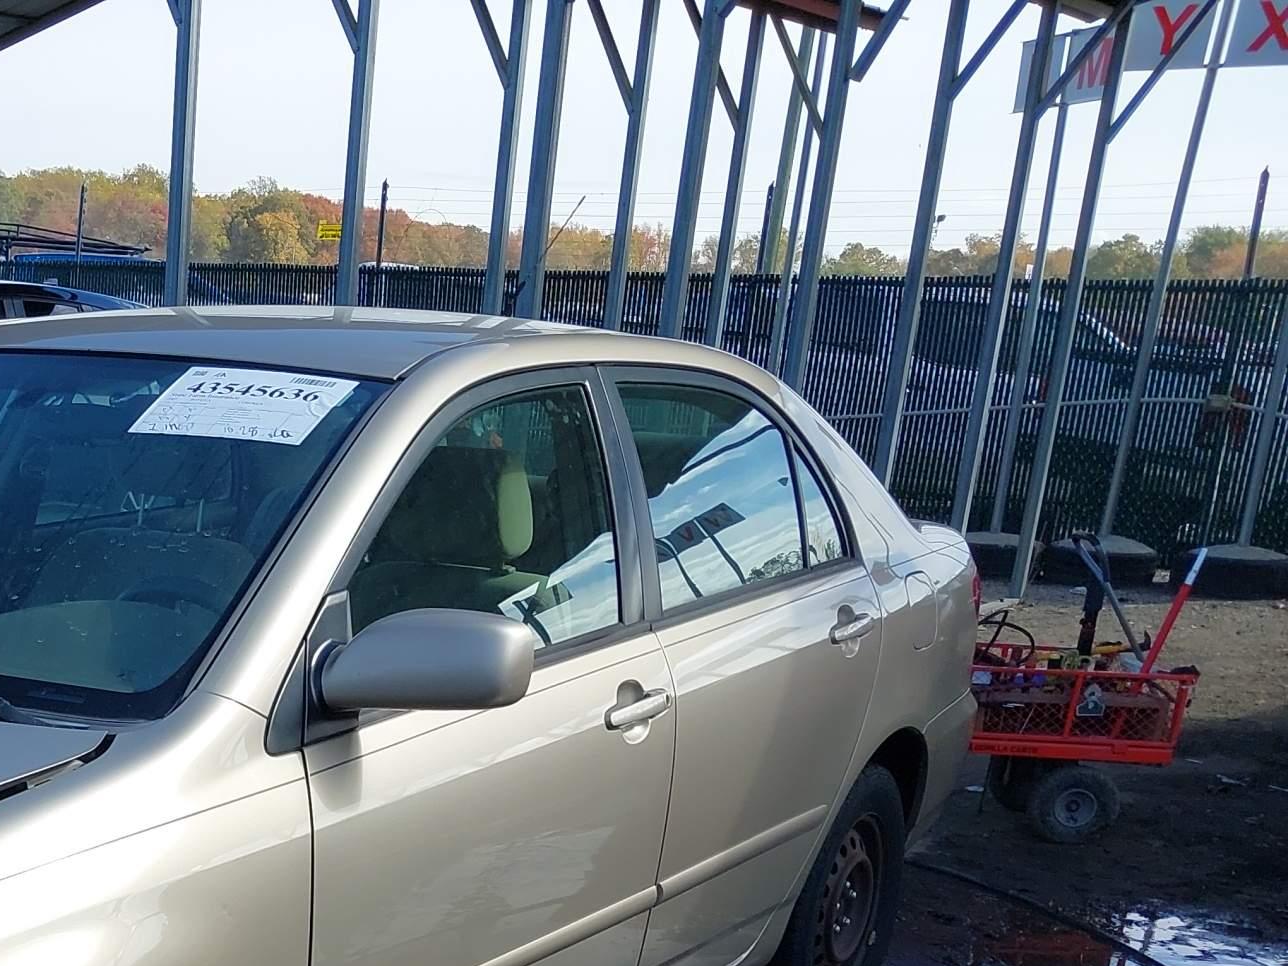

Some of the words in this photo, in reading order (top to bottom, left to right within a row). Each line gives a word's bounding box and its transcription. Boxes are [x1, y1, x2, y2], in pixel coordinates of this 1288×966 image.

[1153, 4, 1199, 55] Y
[1246, 0, 1288, 52] X
[187, 381, 320, 403] 43545636
